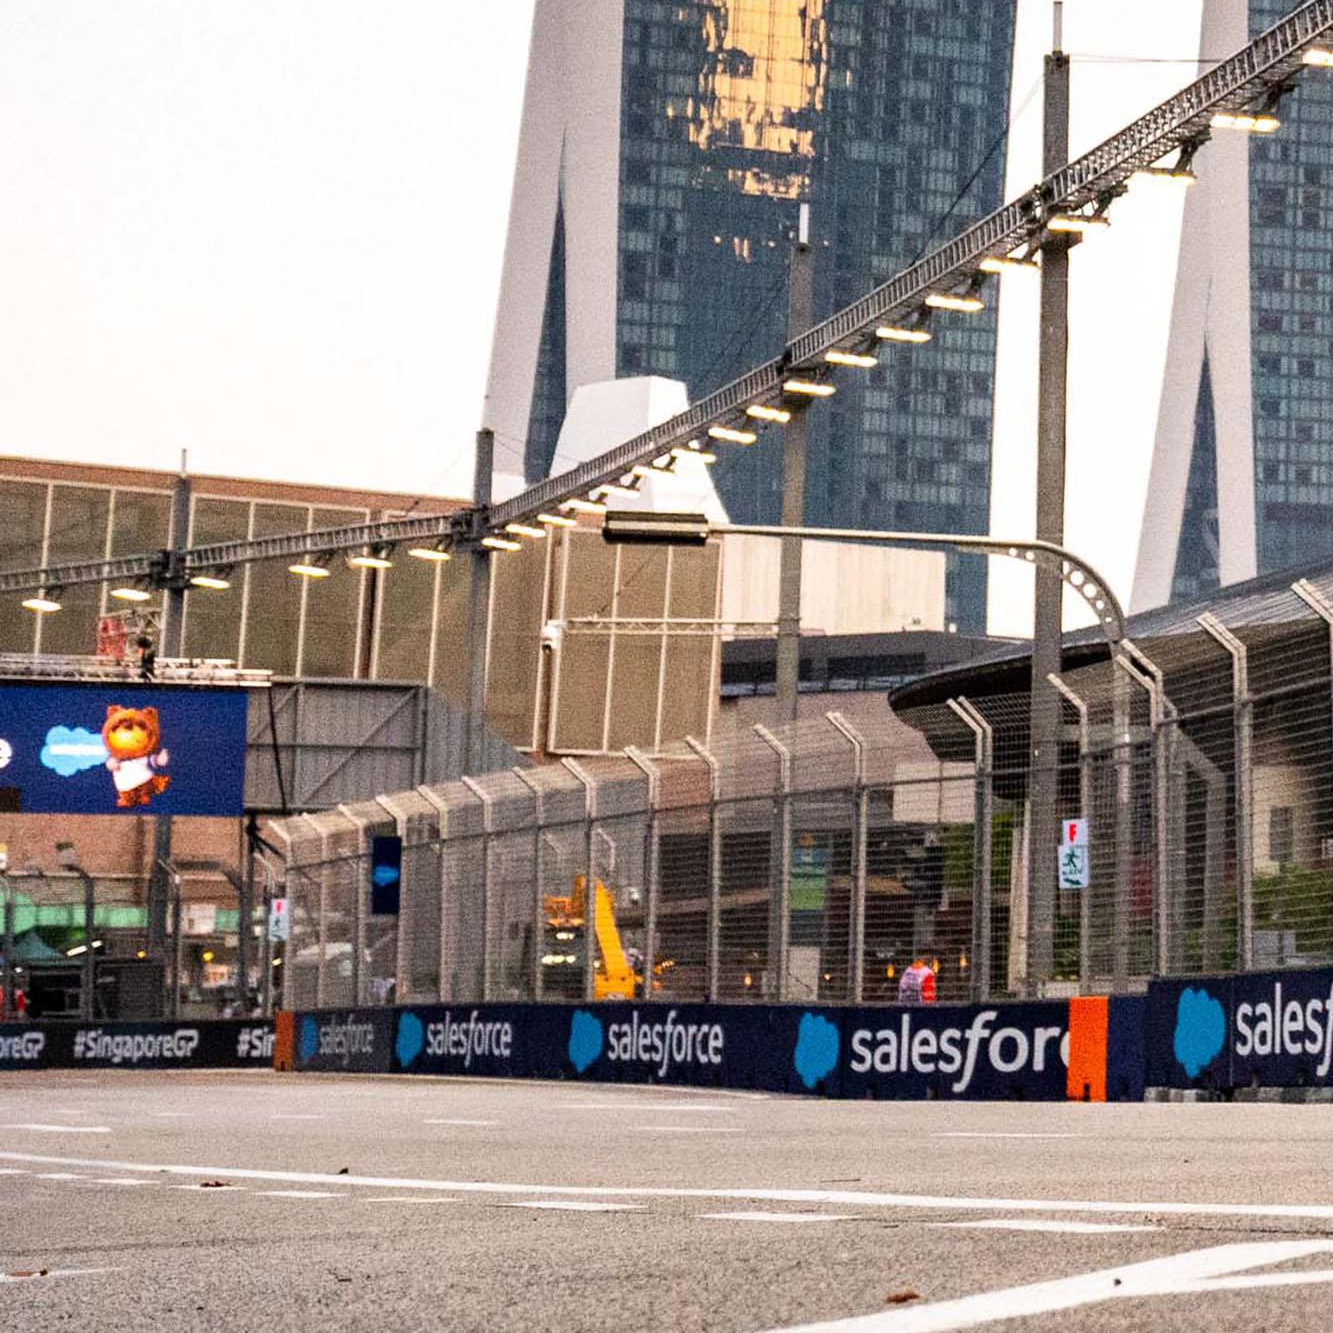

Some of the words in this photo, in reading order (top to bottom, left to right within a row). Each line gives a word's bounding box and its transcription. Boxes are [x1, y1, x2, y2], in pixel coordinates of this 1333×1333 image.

[74, 1028, 199, 1063] #SingaporeGP
[426, 1010, 513, 1068] salesforce
[608, 1010, 724, 1077] salesforce
[850, 1011, 1070, 1093] salesfor
